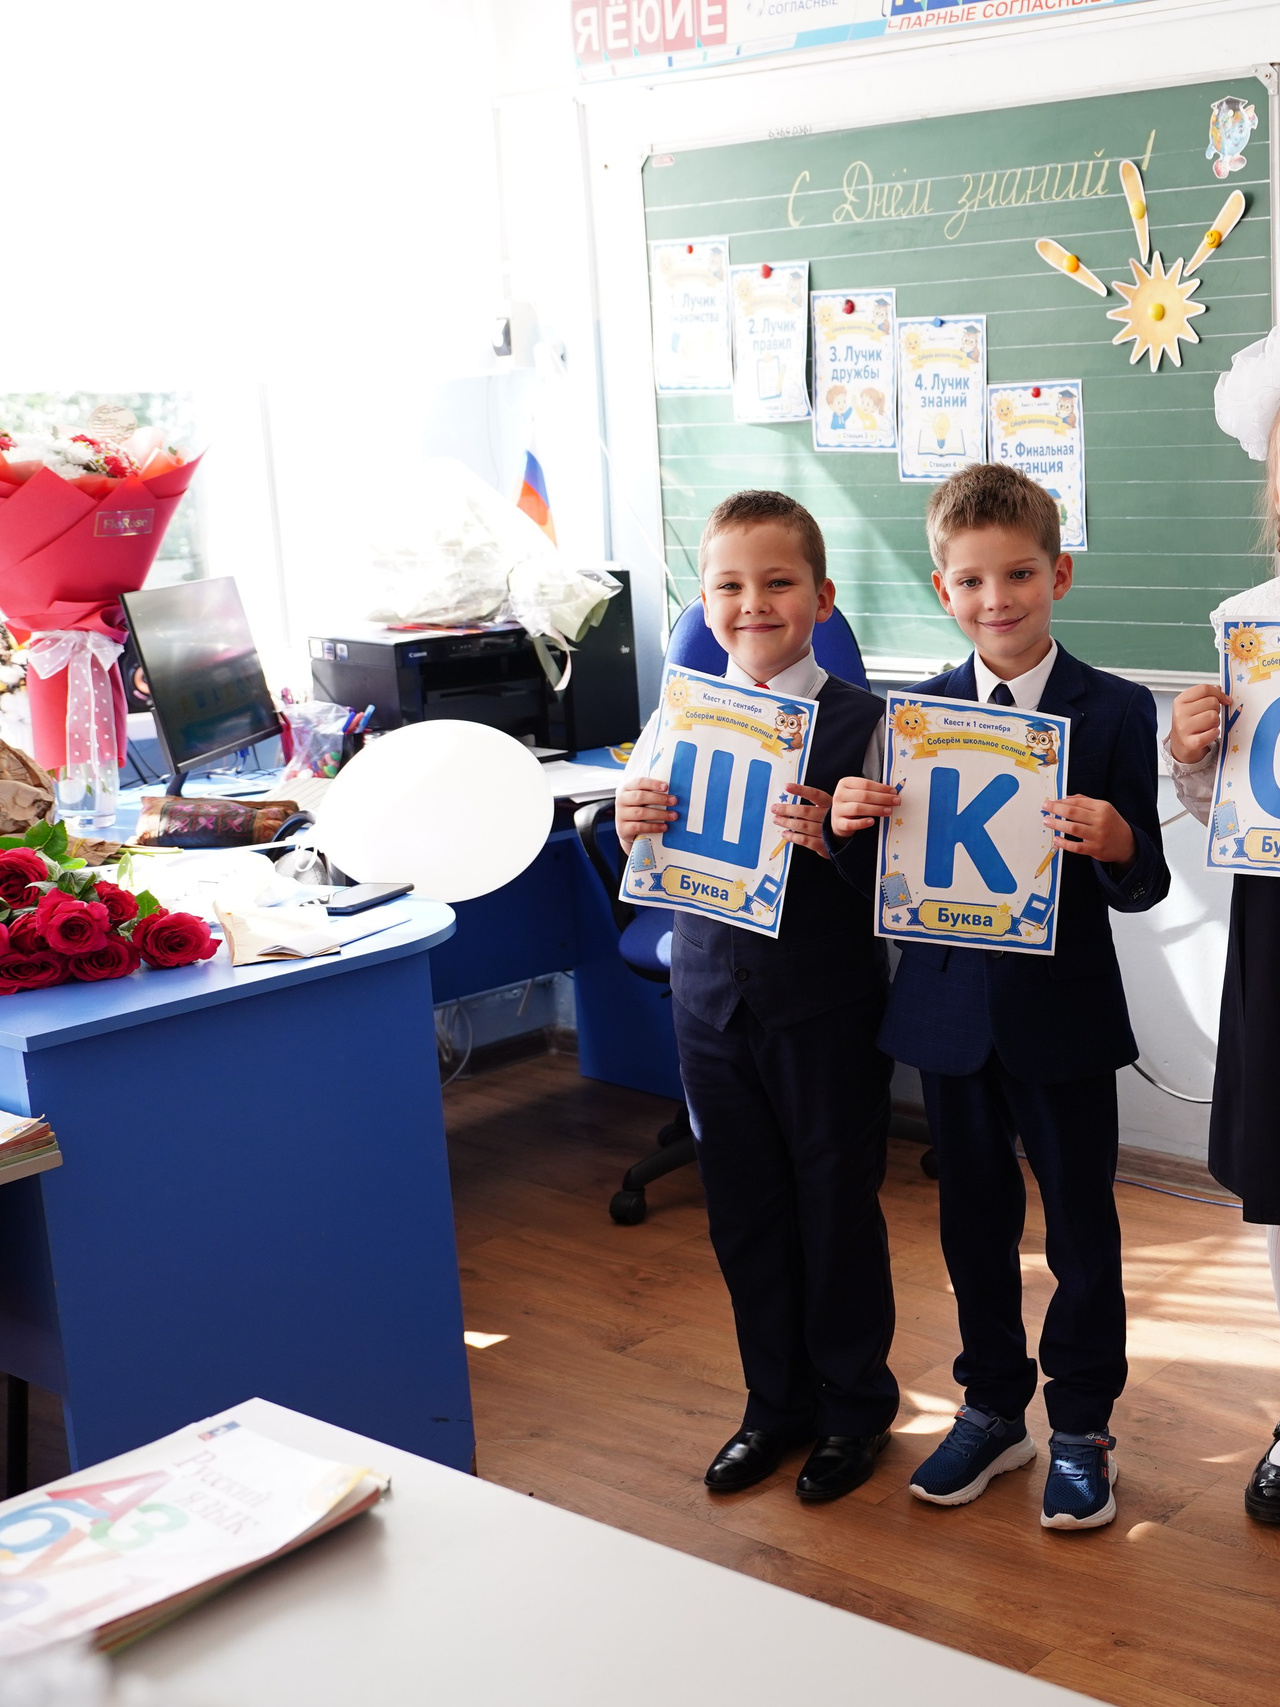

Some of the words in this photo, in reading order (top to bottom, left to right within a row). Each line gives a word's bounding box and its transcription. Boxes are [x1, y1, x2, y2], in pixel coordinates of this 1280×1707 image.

[898, 6, 977, 30] ПАРНЫЕ
[787, 170, 810, 228] С
[832, 160, 934, 223] Днём
[682, 294, 716, 312] Лучик
[749, 319, 759, 334] 2.
[762, 318, 796, 336] Лучик
[753, 338, 792, 354] правил
[829, 346, 841, 362] 3.
[844, 346, 882, 365] Лучик
[831, 365, 880, 384] дружбы
[915, 374, 928, 391] 4.
[931, 373, 970, 394] Лучик
[920, 392, 968, 408] знаний
[1000, 443, 1013, 459] 5.
[1015, 441, 1075, 458] Финальная
[702, 692, 721, 703] Квест
[733, 701, 762, 714] сентября
[685, 710, 714, 721] Соберём
[716, 715, 749, 729] школьное
[750, 724, 774, 740] солнце
[943, 717, 964, 727] Квест
[979, 723, 1011, 733] сентября
[927, 737, 960, 746] Соберём
[962, 738, 999, 748] школьное
[1001, 743, 1026, 757] солнце
[661, 740, 772, 870] Ш
[923, 766, 1020, 895] К
[679, 874, 729, 902] Буква
[937, 907, 993, 928] Буква
